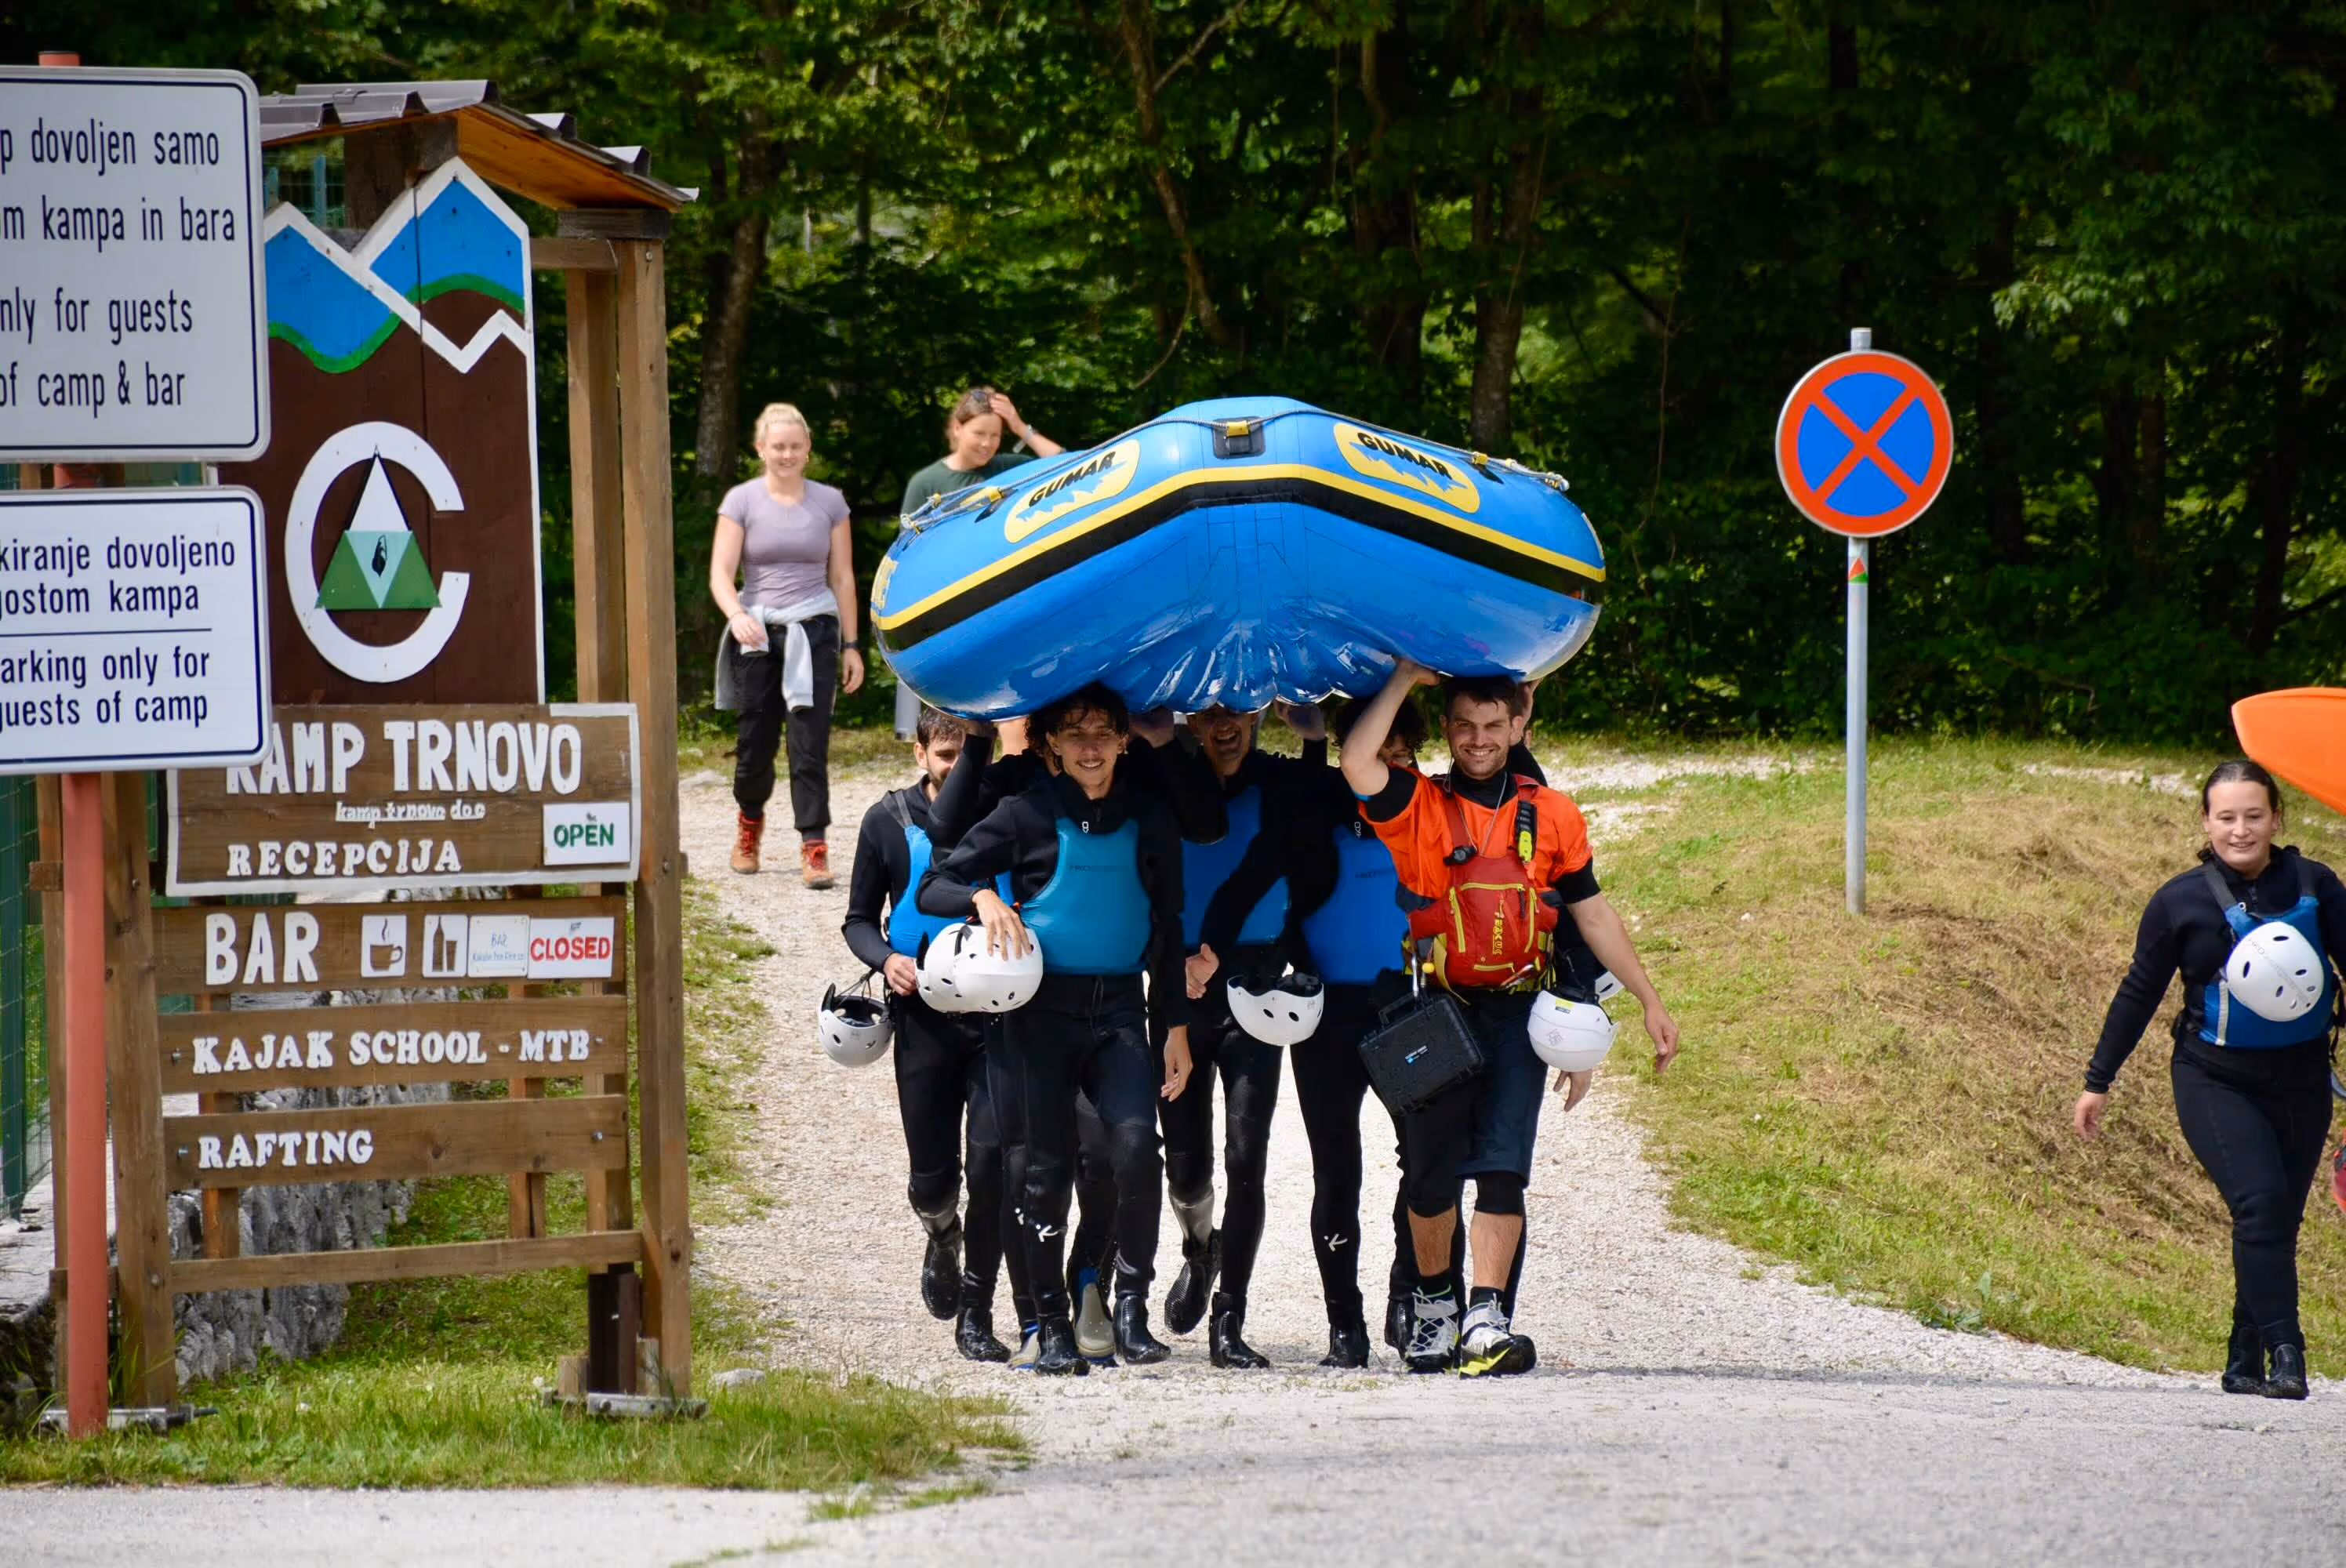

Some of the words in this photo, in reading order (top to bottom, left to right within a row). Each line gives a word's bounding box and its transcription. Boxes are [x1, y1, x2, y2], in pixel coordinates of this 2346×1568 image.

[31, 117, 136, 176] dovoljen
[154, 131, 219, 165] samo
[42, 194, 125, 253] kampa
[142, 197, 163, 241] in
[180, 196, 235, 241] bara
[54, 287, 89, 332] for
[108, 289, 192, 346] guests
[38, 373, 105, 419] camp
[118, 360, 131, 405] &
[145, 361, 185, 406] bar
[1357, 432, 1453, 480] GUMAR
[1029, 452, 1116, 507] GUMAR
[107, 535, 234, 575] dovoljeno
[0, 583, 89, 622] ostom
[109, 579, 198, 619] kampa
[103, 647, 158, 687] only
[172, 645, 209, 678] for
[0, 694, 80, 734] uests
[96, 690, 122, 724] of
[135, 695, 208, 731] camp
[383, 719, 582, 794] TRNOVO
[336, 800, 380, 829] kamp
[382, 802, 446, 822] trnovo
[553, 822, 615, 848] OPEN
[227, 839, 461, 876] RECEPCIJA
[206, 912, 319, 985] BAR
[530, 936, 611, 962] CLOSED
[193, 1031, 333, 1074] KAJAK
[349, 1029, 488, 1065] SCHOOL
[518, 1029, 590, 1062] MTB
[198, 1130, 373, 1168] RAFTING
